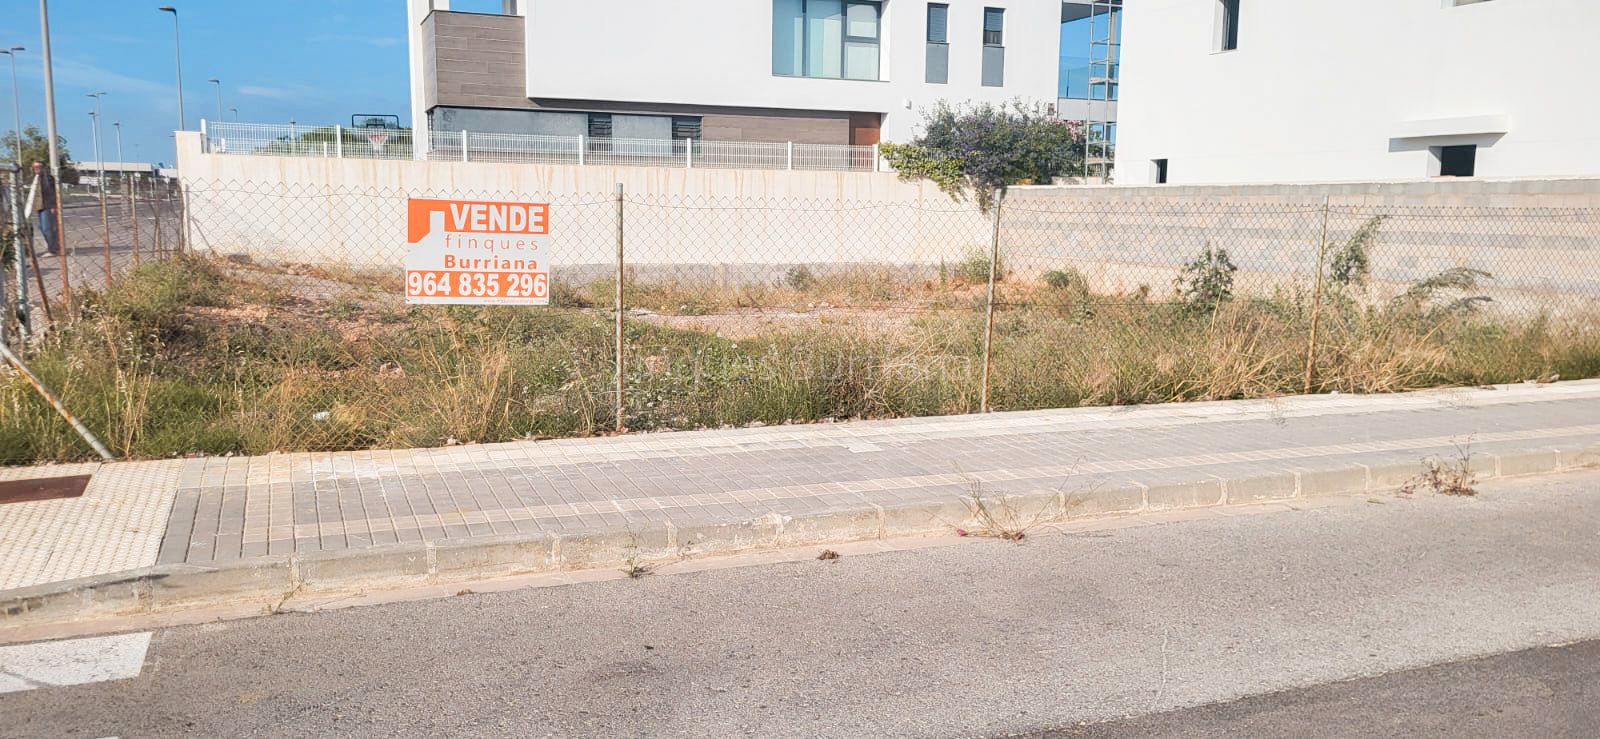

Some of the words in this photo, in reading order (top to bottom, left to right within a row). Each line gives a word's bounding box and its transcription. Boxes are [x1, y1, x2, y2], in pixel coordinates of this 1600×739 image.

[449, 203, 544, 232] VENDE
[444, 234, 538, 253] finques
[444, 254, 537, 269] Burriana
[408, 272, 451, 296] 964
[459, 273, 500, 297] 835
[506, 274, 546, 297] 296
